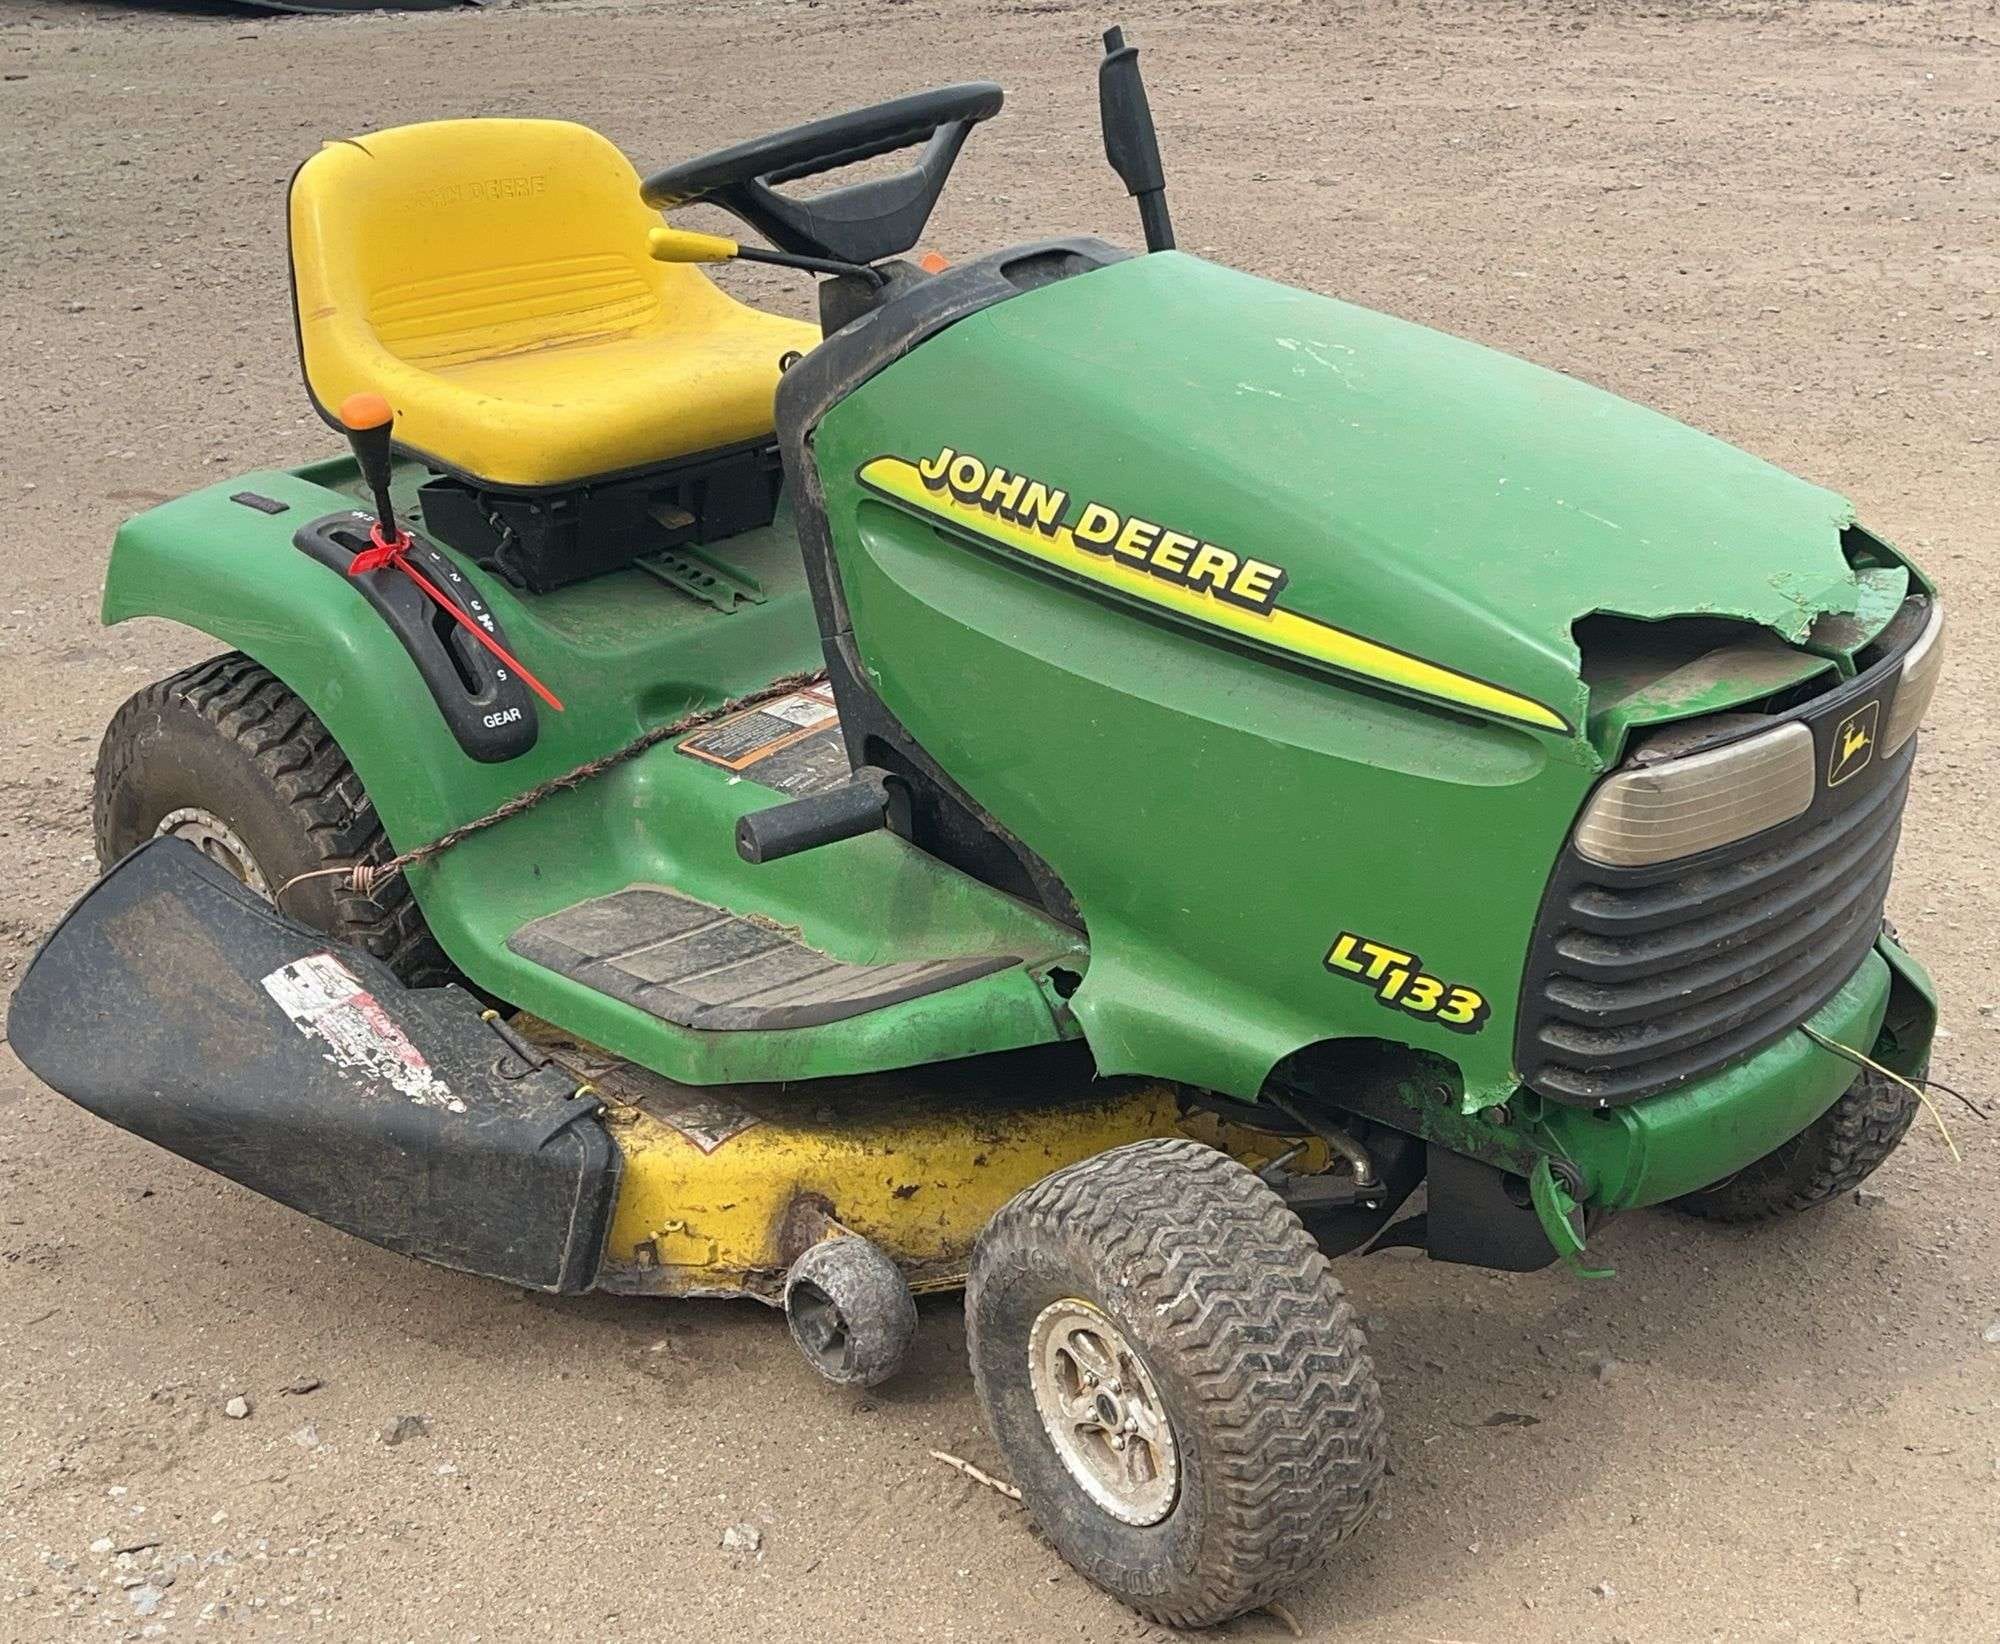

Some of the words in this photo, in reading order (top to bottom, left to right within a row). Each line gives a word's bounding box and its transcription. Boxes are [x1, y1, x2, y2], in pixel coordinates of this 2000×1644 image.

[468, 175, 545, 201] DEERE
[919, 446, 1069, 530] JOHN
[1074, 502, 1286, 608] DEERE
[483, 707, 522, 729] GEAR
